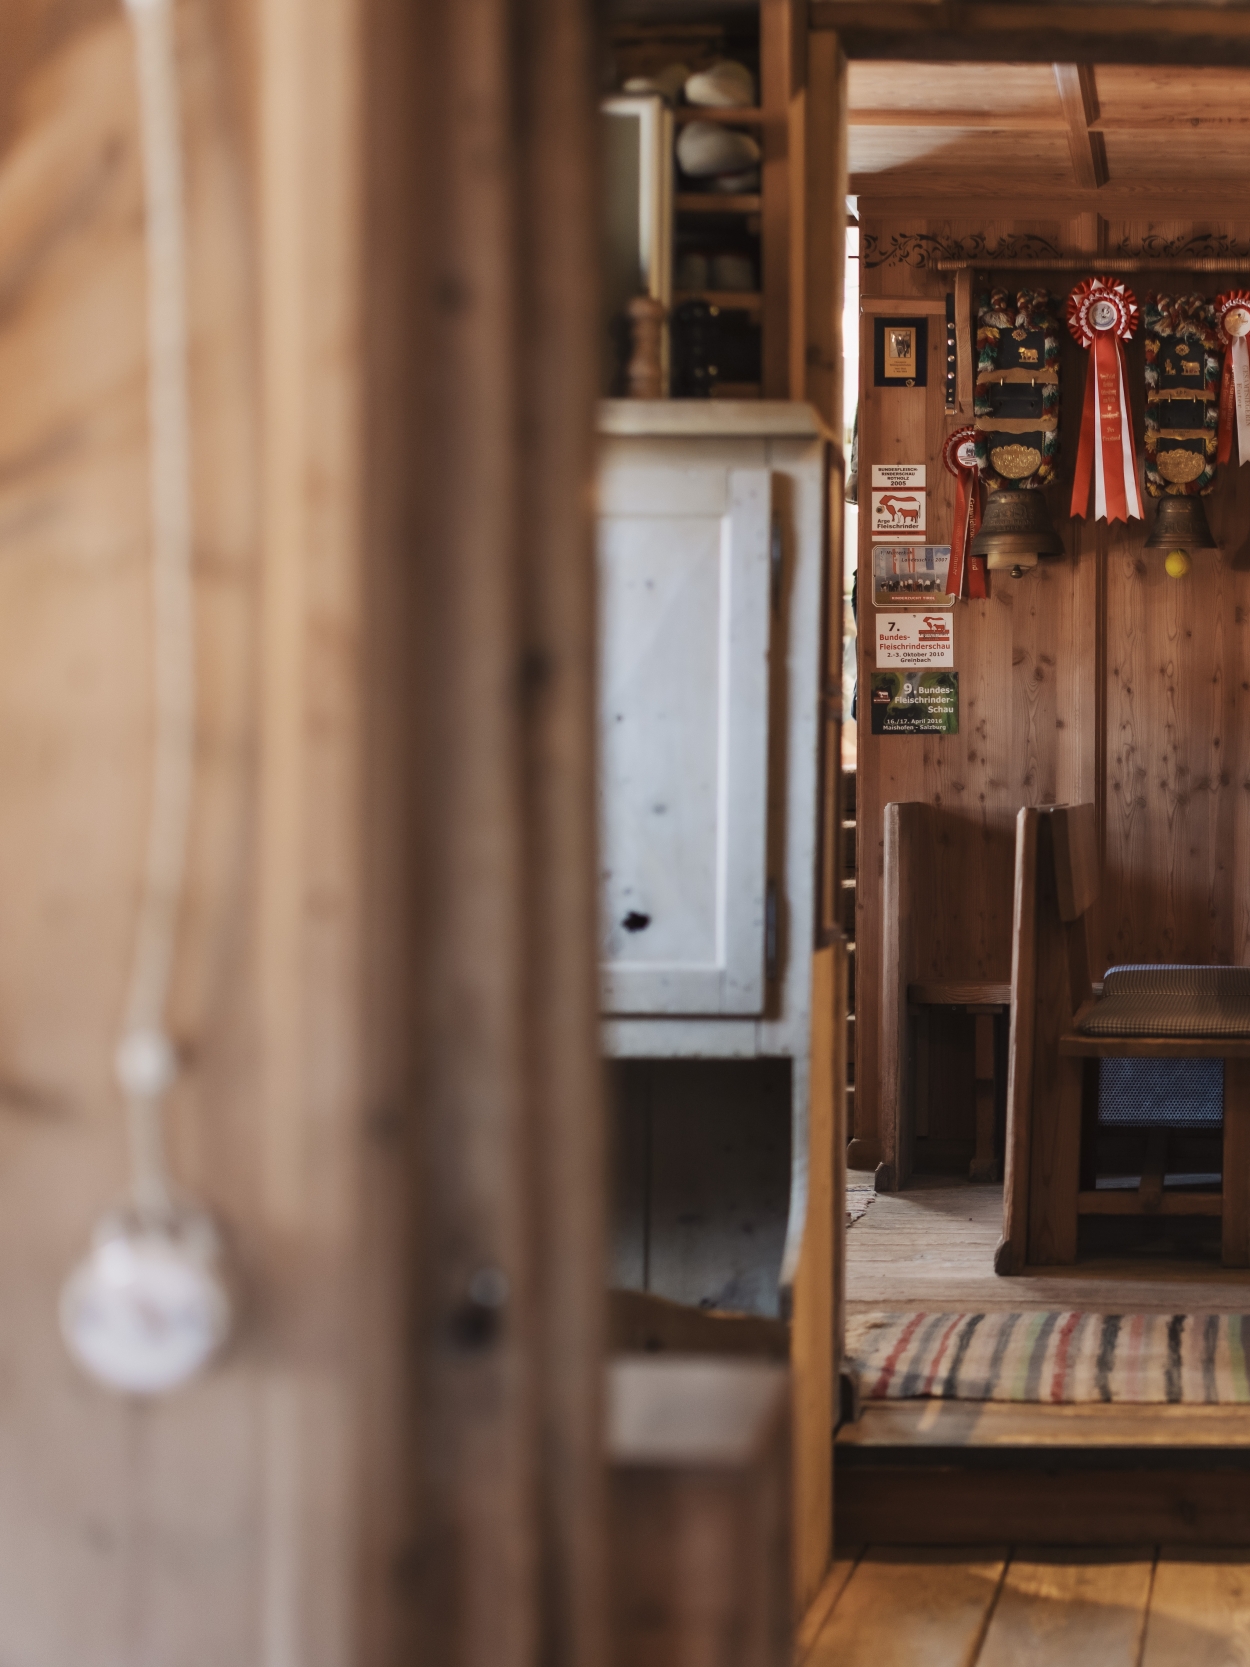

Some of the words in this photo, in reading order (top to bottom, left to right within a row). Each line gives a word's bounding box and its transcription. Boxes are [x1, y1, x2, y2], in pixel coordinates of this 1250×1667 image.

[888, 622, 901, 632] 7.
[904, 682, 917, 694] 9.
[928, 706, 954, 714] Schau
